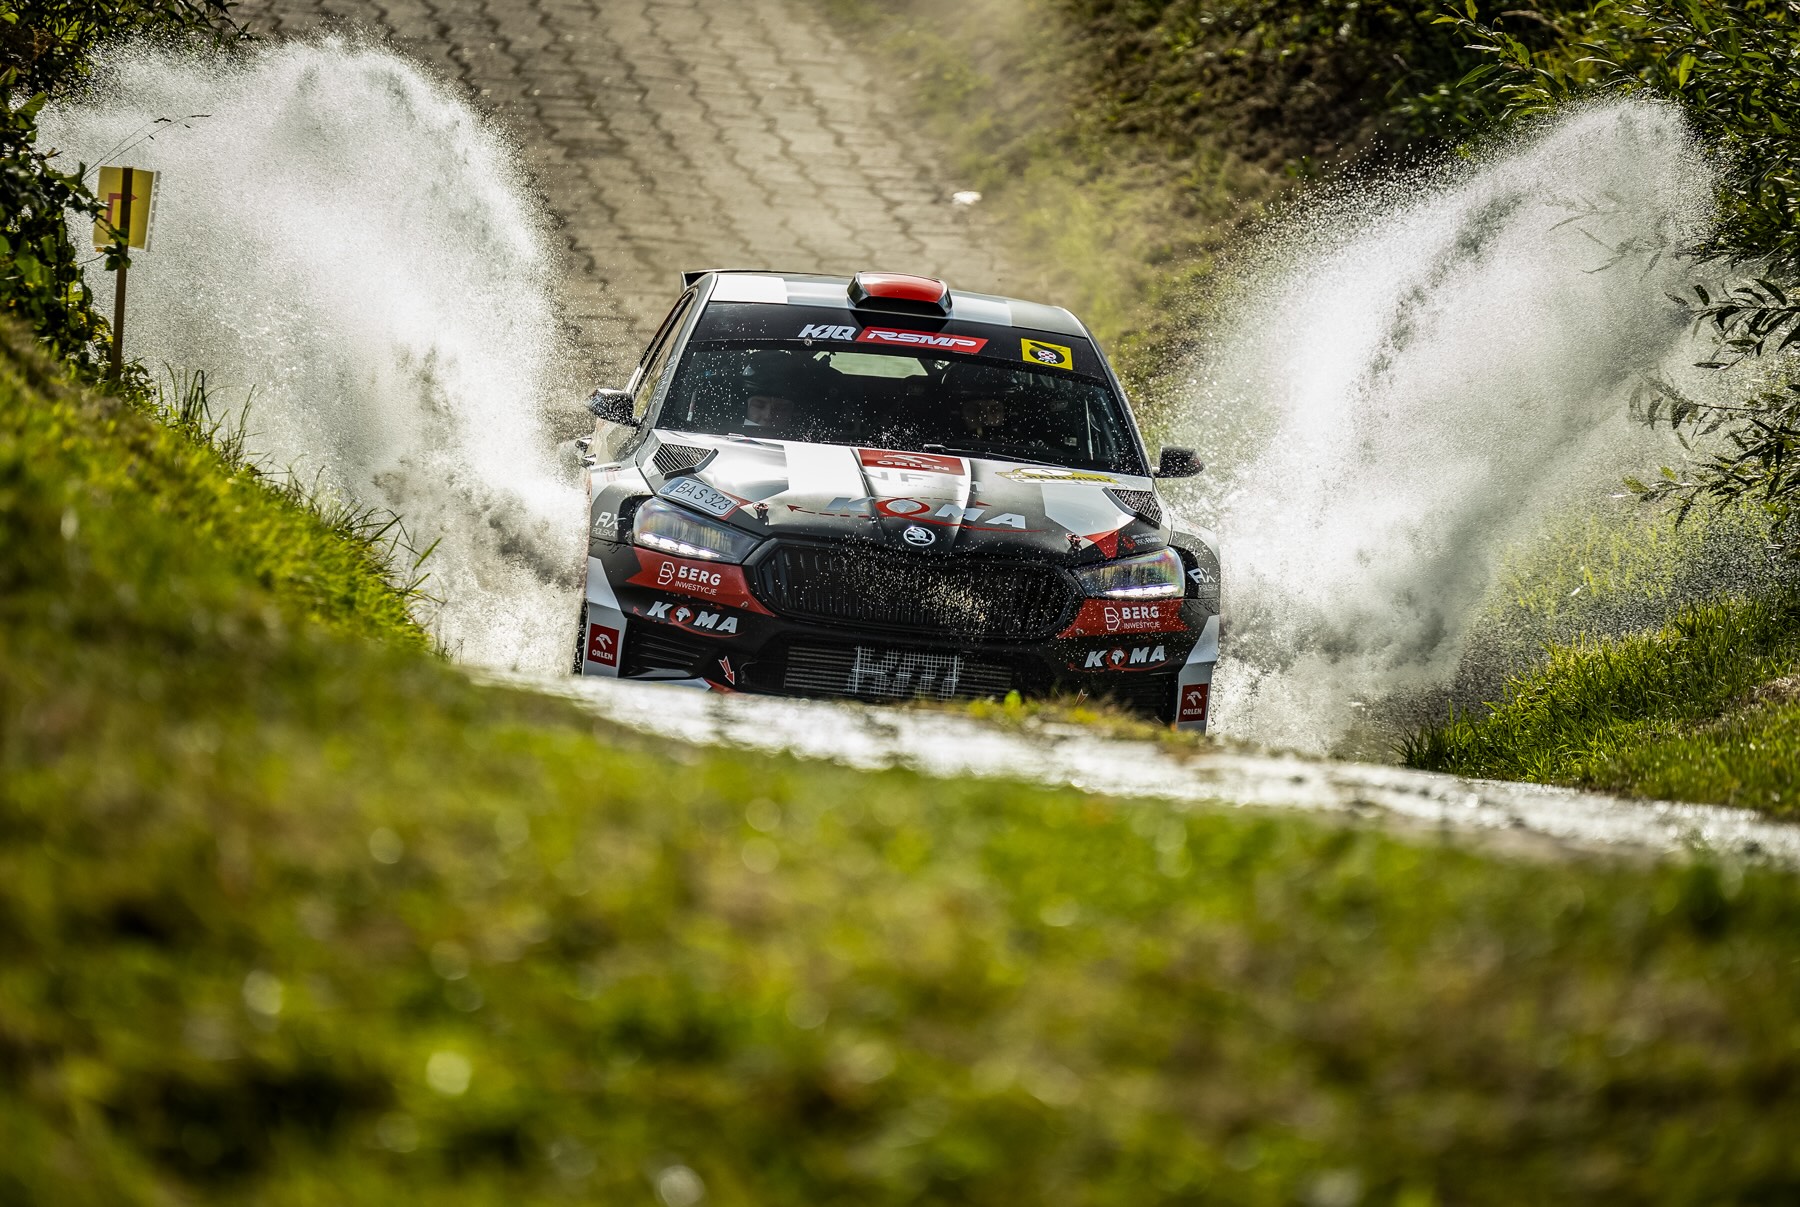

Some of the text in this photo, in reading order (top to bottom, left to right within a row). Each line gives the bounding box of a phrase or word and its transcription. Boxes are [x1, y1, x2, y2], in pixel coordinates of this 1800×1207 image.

[867, 330, 977, 347] RSMP
[877, 460, 950, 471] ORLEN
[676, 482, 732, 511] BA S 323
[595, 511, 626, 530] RX
[592, 528, 617, 537] POLSKA
[677, 566, 722, 586] BERG
[674, 580, 718, 596] INWESTYCJE
[647, 600, 738, 634] KOMA
[1121, 606, 1160, 620] BERG
[1122, 621, 1161, 630] INWESTYCJE
[591, 649, 613, 661] ORLEN
[1084, 645, 1166, 668] KOMA
[1182, 707, 1202, 716] ORLEN
